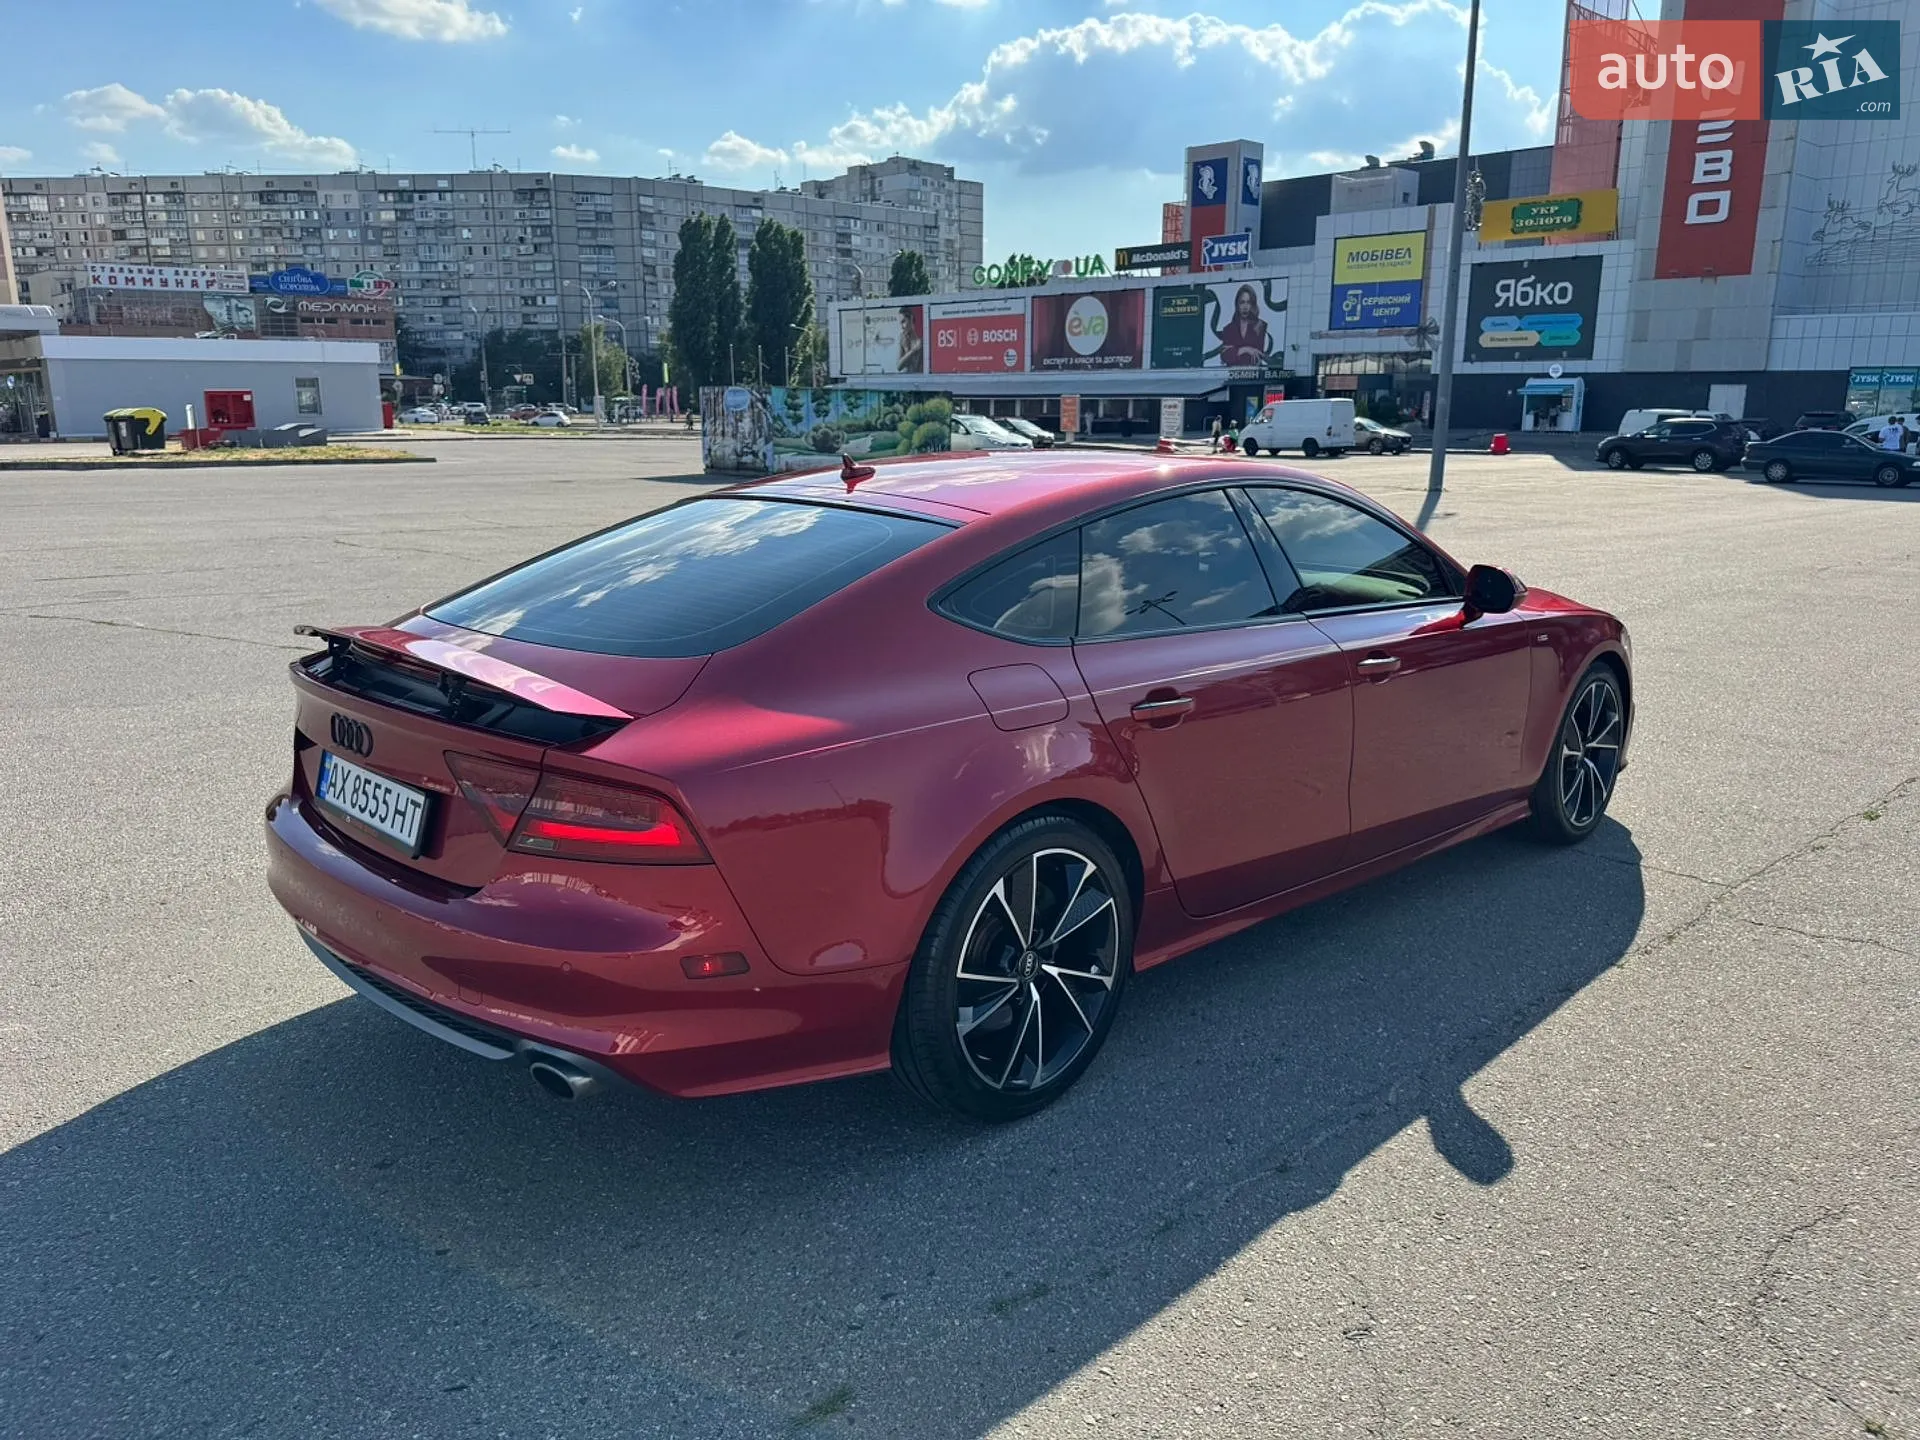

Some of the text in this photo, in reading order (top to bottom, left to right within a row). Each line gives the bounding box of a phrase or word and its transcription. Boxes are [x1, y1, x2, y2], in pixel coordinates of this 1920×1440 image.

[1530, 205, 1559, 215] УКР
[1515, 215, 1573, 228] ЗОЛОТО
[1211, 240, 1248, 257] JYSK
[1347, 247, 1412, 264] МОБІВЕЛ
[1131, 249, 1189, 264] McDonald's
[1075, 254, 1106, 277] UA
[92, 274, 217, 290] КОММУНАР
[1494, 275, 1573, 308] Ябко
[1362, 293, 1412, 306] СЕРВІСНИЙ
[1372, 307, 1401, 317] ЦЕНТР
[982, 329, 1018, 343] BOSCH
[1855, 374, 1880, 383] JYSK
[1889, 374, 1914, 383] JYSK
[326, 762, 422, 839] AX 8555 HT
